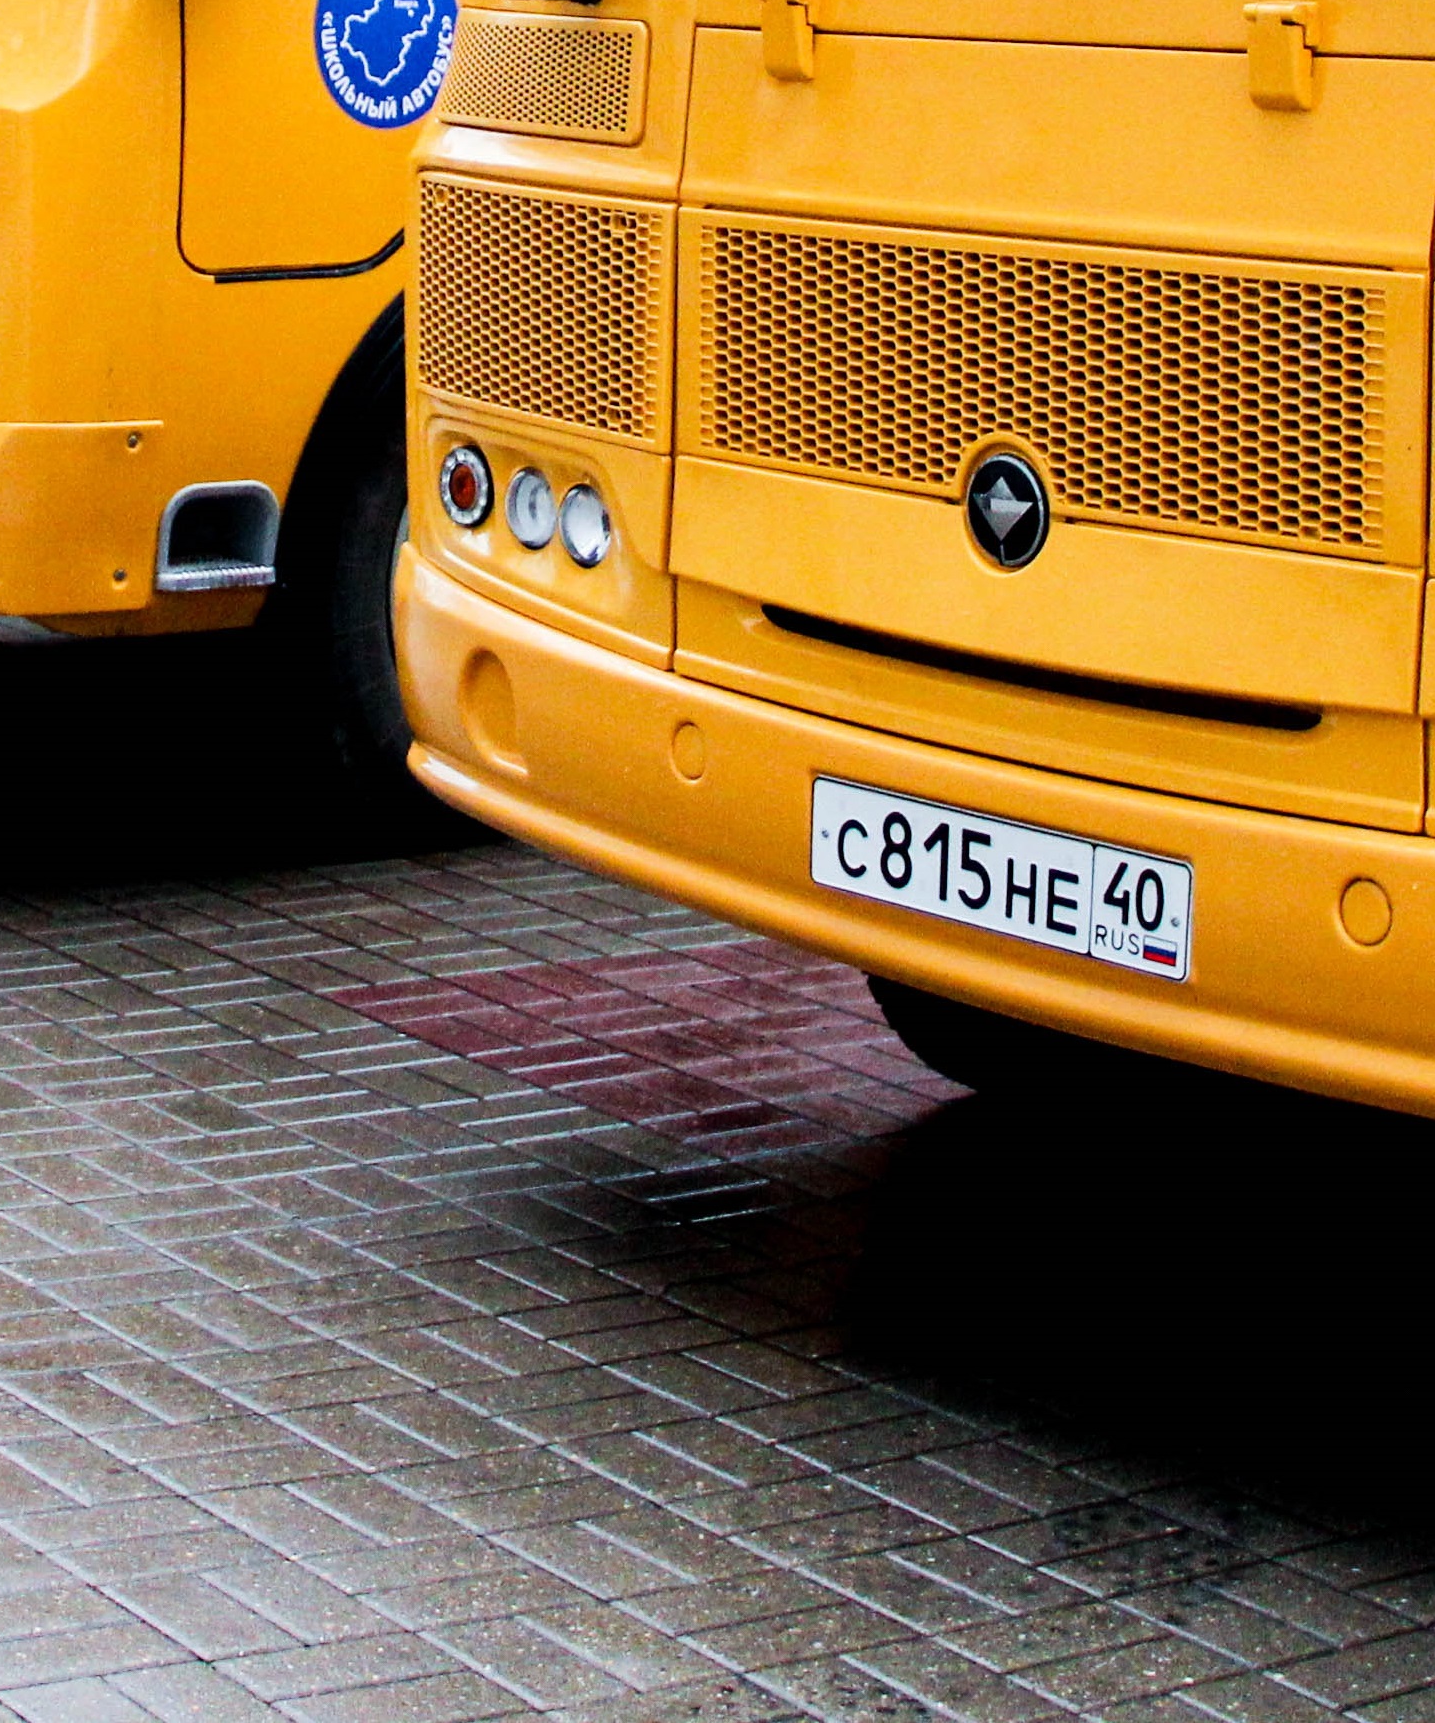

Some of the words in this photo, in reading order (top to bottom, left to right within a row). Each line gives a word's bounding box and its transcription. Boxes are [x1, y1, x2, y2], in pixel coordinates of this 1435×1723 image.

[837, 812, 1079, 936] С815НЕ
[1103, 862, 1165, 932] 40
[1094, 924, 1140, 957] RUS
